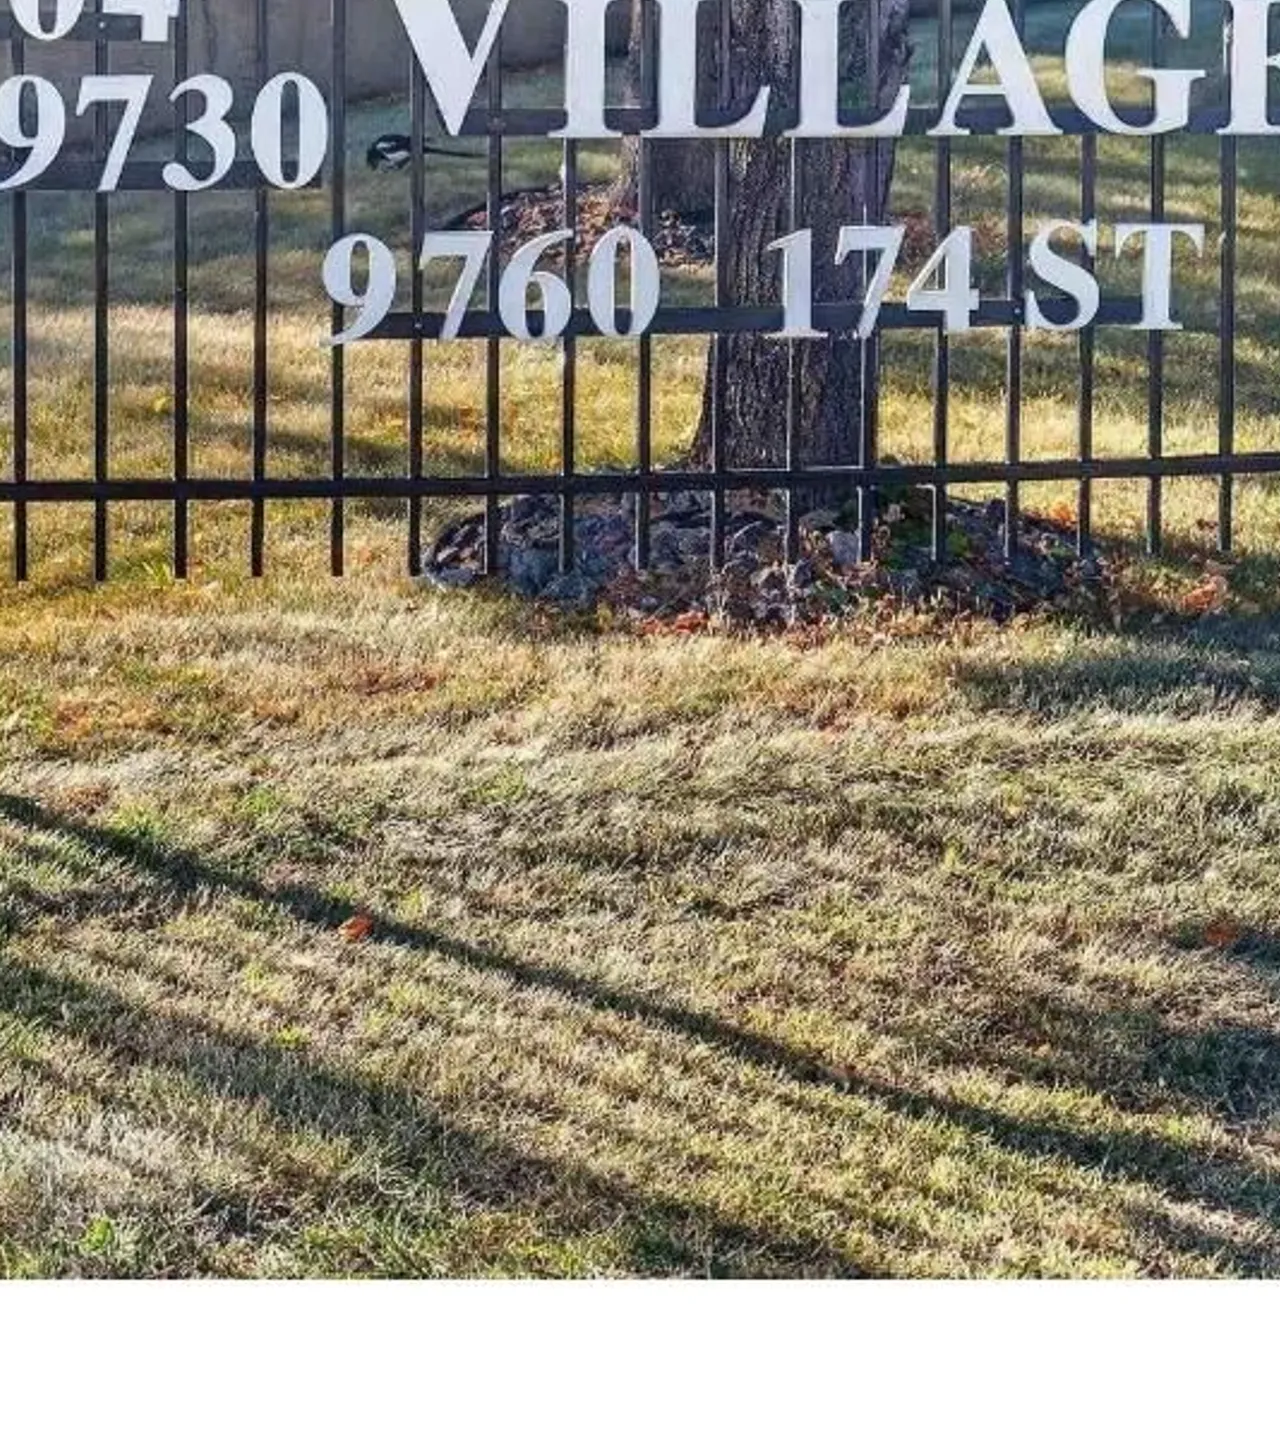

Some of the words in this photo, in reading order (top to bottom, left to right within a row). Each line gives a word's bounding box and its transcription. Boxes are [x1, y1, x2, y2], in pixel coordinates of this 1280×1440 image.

[322, 224, 660, 344] 9760
[764, 224, 980, 338] 174
[1023, 219, 1205, 331] ST
